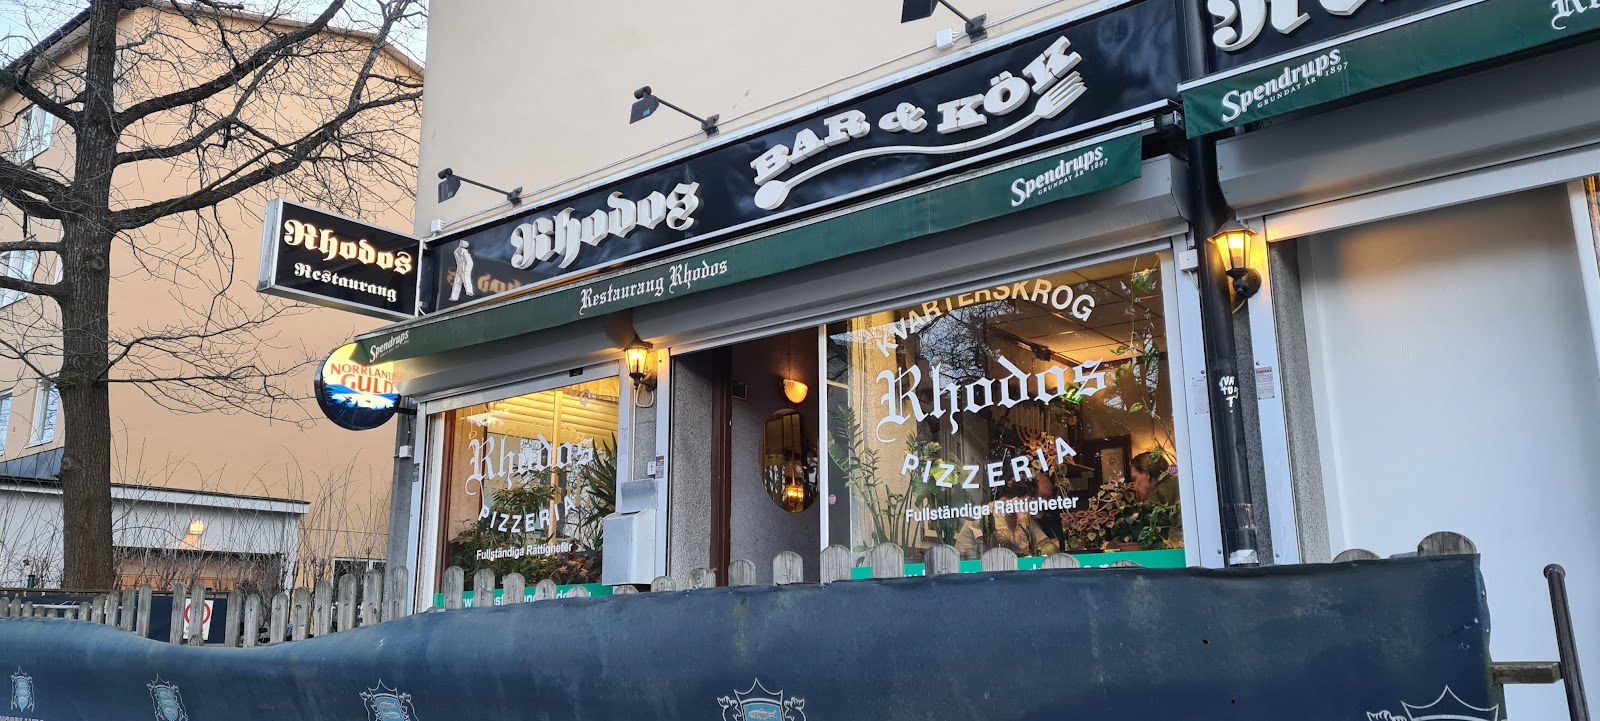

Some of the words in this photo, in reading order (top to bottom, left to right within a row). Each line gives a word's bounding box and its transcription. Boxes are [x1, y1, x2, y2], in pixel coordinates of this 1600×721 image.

[750, 109, 870, 186] BAR
[878, 102, 928, 133] &
[937, 35, 1083, 134] KÖK
[1222, 48, 1341, 122] Spendrups
[1257, 83, 1301, 108] GRUNDAT
[1304, 76, 1317, 87] ÅR
[1325, 62, 1348, 77] 1897
[1011, 146, 1104, 207] Spendrups
[1038, 175, 1072, 195] GRUNDAT
[1090, 158, 1108, 171] 1897
[284, 219, 412, 275] Rhodos
[510, 181, 700, 270] Rhodos
[294, 262, 397, 303] Restaurang
[579, 277, 664, 315] Restaurang
[668, 259, 728, 294] Rhodos
[370, 330, 409, 363] Spendrups
[341, 374, 393, 394] GULD
[875, 355, 1107, 443] Rhodos
[465, 432, 594, 496] Rhodos
[900, 437, 1077, 490] PIZZERIA
[478, 496, 577, 533] PIZZERIA
[905, 503, 991, 523] Fullständiga
[994, 495, 1079, 518] Rättigheter
[476, 546, 525, 560] Fullständiga
[526, 541, 573, 557] Rättigheter
